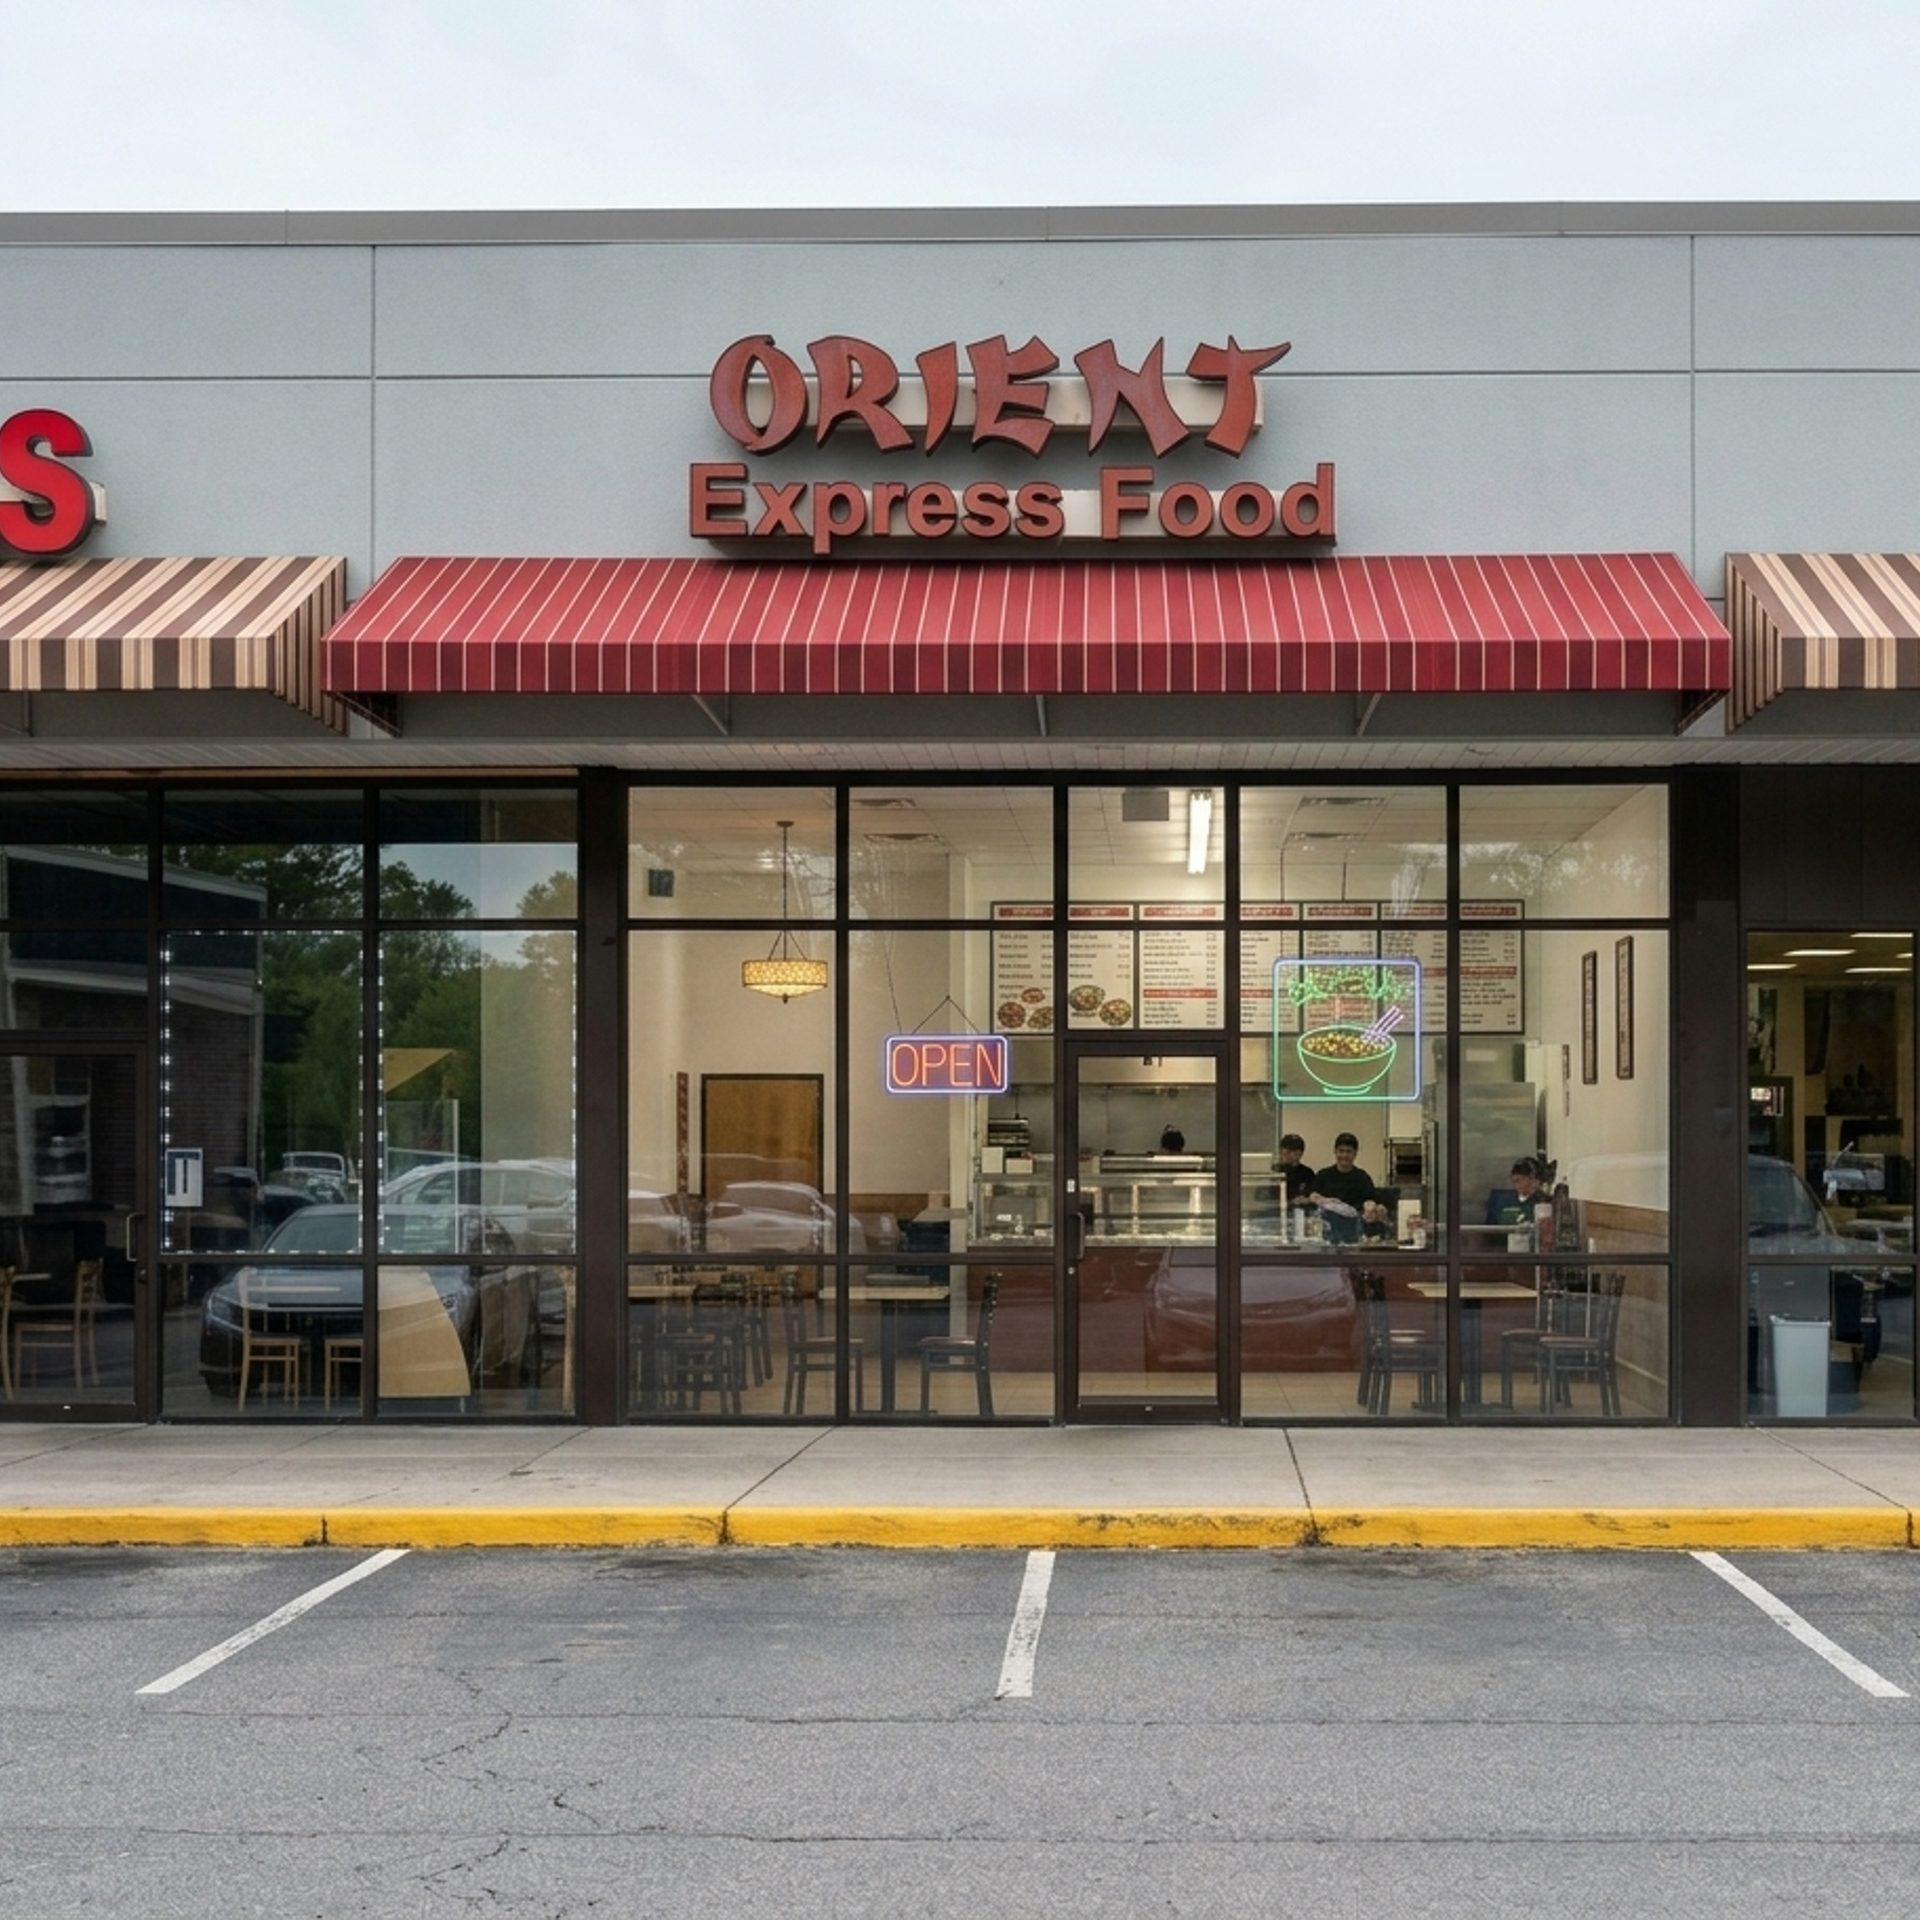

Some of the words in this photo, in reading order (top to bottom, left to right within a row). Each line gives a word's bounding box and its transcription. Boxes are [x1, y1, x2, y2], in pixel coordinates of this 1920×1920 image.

[709, 334, 1291, 458] ORIENT
[689, 462, 1066, 555] Express
[1100, 462, 1336, 541] Food
[892, 1043, 1002, 1087] OPEN
